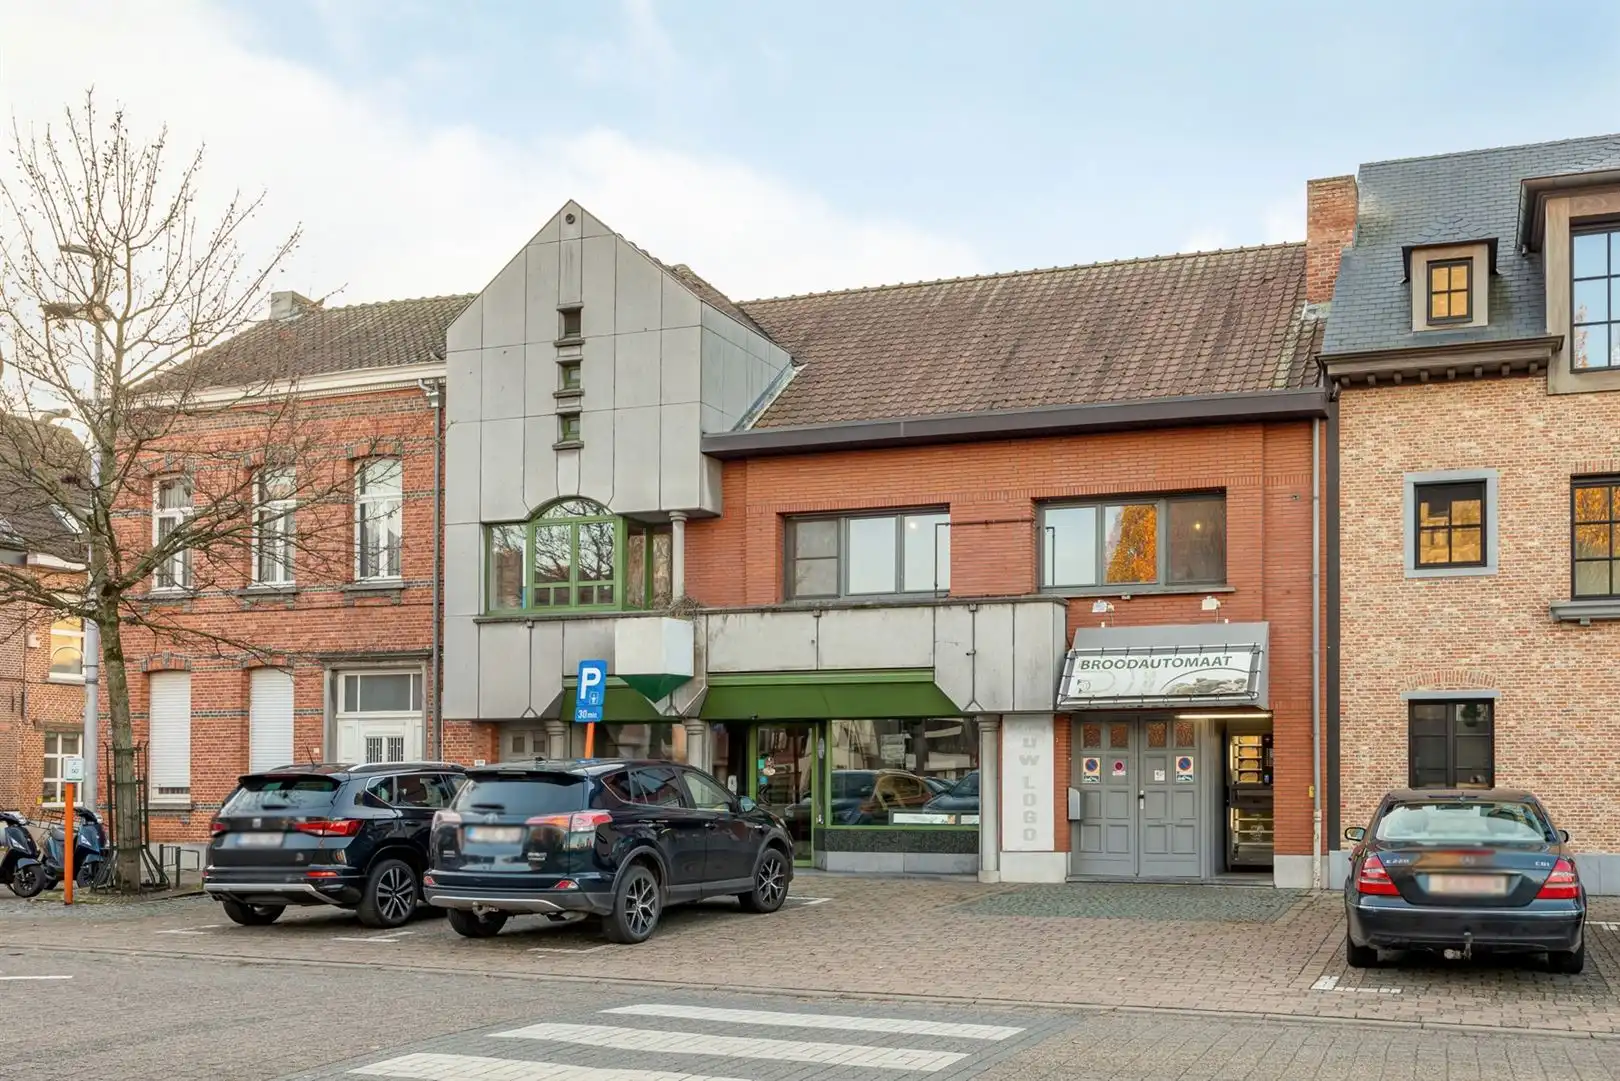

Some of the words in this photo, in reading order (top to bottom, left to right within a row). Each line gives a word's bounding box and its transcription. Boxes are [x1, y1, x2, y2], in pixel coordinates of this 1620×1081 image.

[1080, 655, 1233, 671] BROODAUTOMAAT
[580, 667, 602, 699] P
[577, 709, 588, 719] 30
[1023, 776, 1037, 841] LOGO
